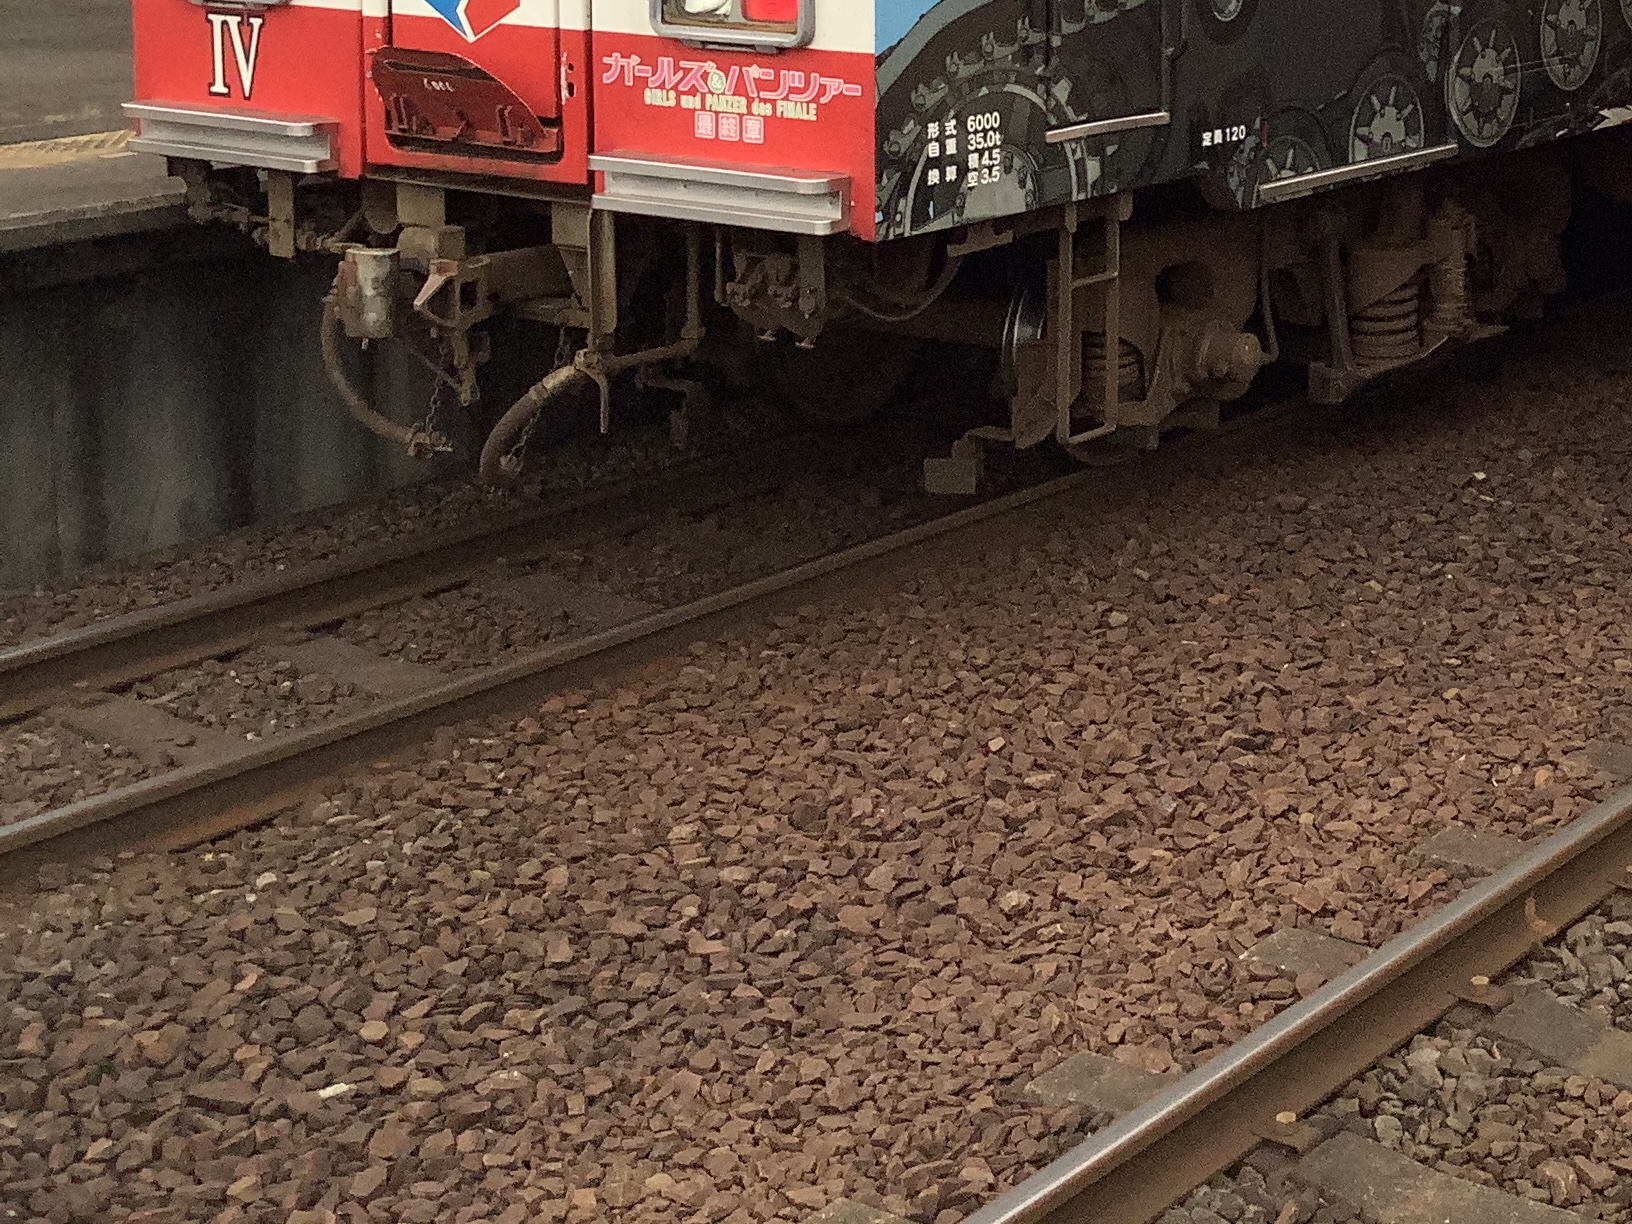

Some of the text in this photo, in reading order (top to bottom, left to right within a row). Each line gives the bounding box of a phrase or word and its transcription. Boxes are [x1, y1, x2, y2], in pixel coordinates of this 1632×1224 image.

[643, 88, 677, 107] GIRLS
[705, 93, 748, 114] PANZER
[776, 100, 818, 121] FINALE
[694, 111, 764, 144] 最終章
[927, 111, 1000, 139] 形式 6000
[967, 130, 1001, 151] 35.0t
